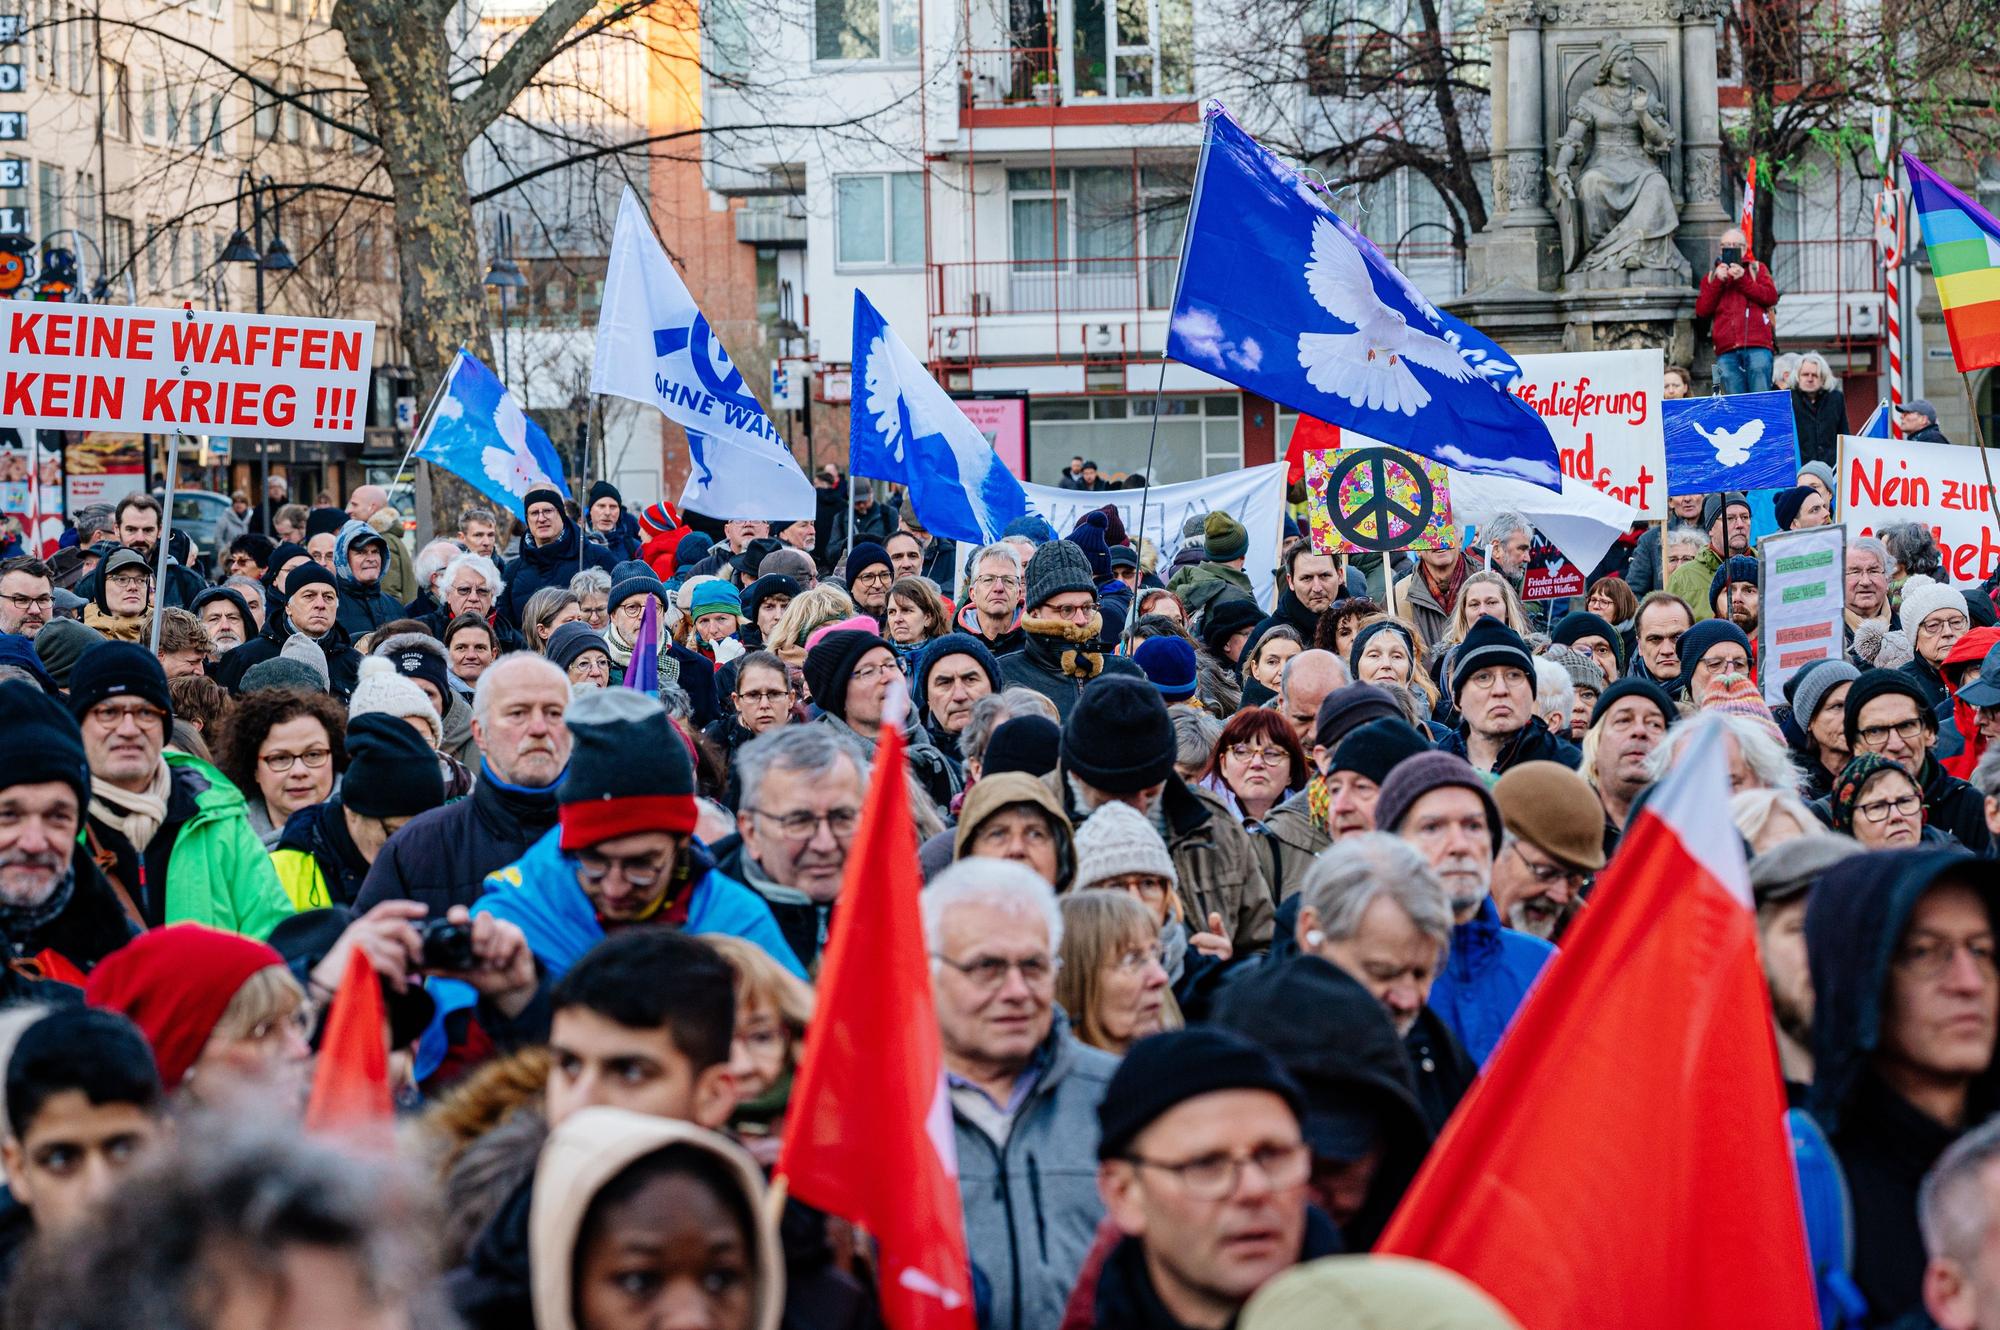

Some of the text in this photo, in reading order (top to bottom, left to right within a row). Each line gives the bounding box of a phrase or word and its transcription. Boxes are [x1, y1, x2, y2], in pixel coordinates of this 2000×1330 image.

[9, 312, 362, 371] KEINE WAFFEN
[3, 371, 357, 430] KEIN KRIEG !!!
[655, 372, 716, 416] OHNE
[1559, 432, 1594, 481] nd
[1850, 457, 1997, 513] Nein zur
[1528, 576, 1552, 587] Frieden
[1528, 586, 1552, 596] OHNE
